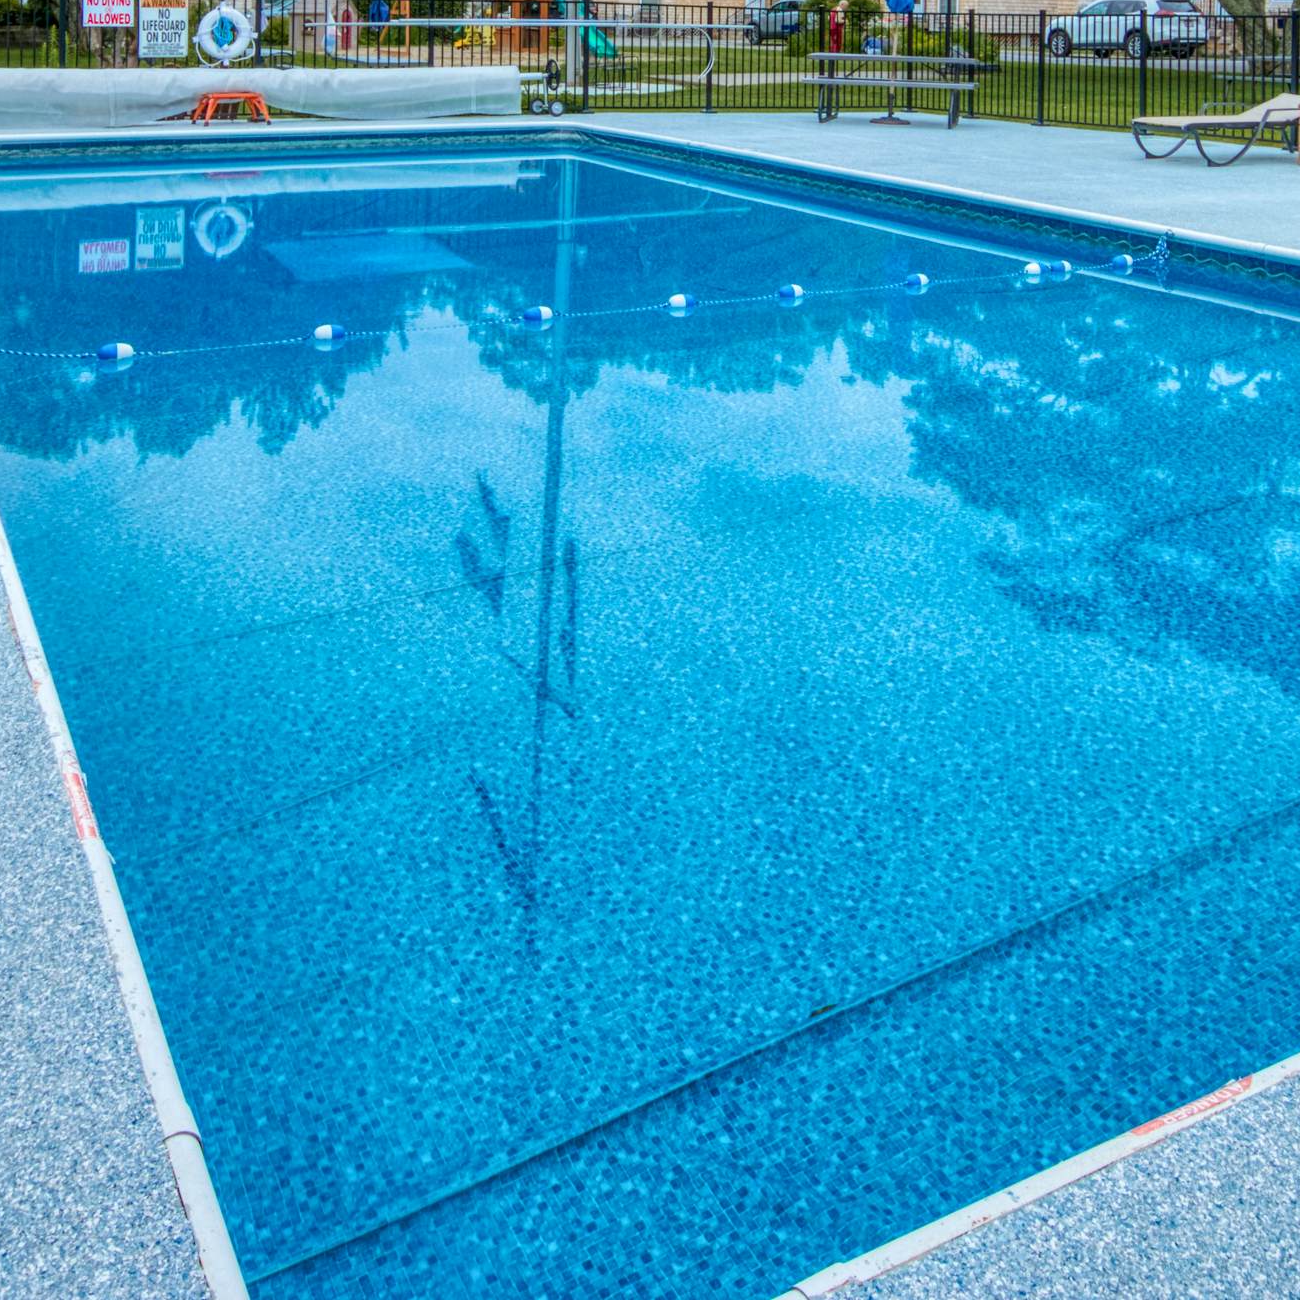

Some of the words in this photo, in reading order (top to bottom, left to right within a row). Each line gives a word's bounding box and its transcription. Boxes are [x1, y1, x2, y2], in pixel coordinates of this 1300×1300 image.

[87, 13, 131, 25] ALLOWED
[158, 8, 171, 20] NO
[142, 20, 186, 31] LIFEGUARD
[146, 32, 159, 43] ON
[161, 32, 182, 43] DUTY
